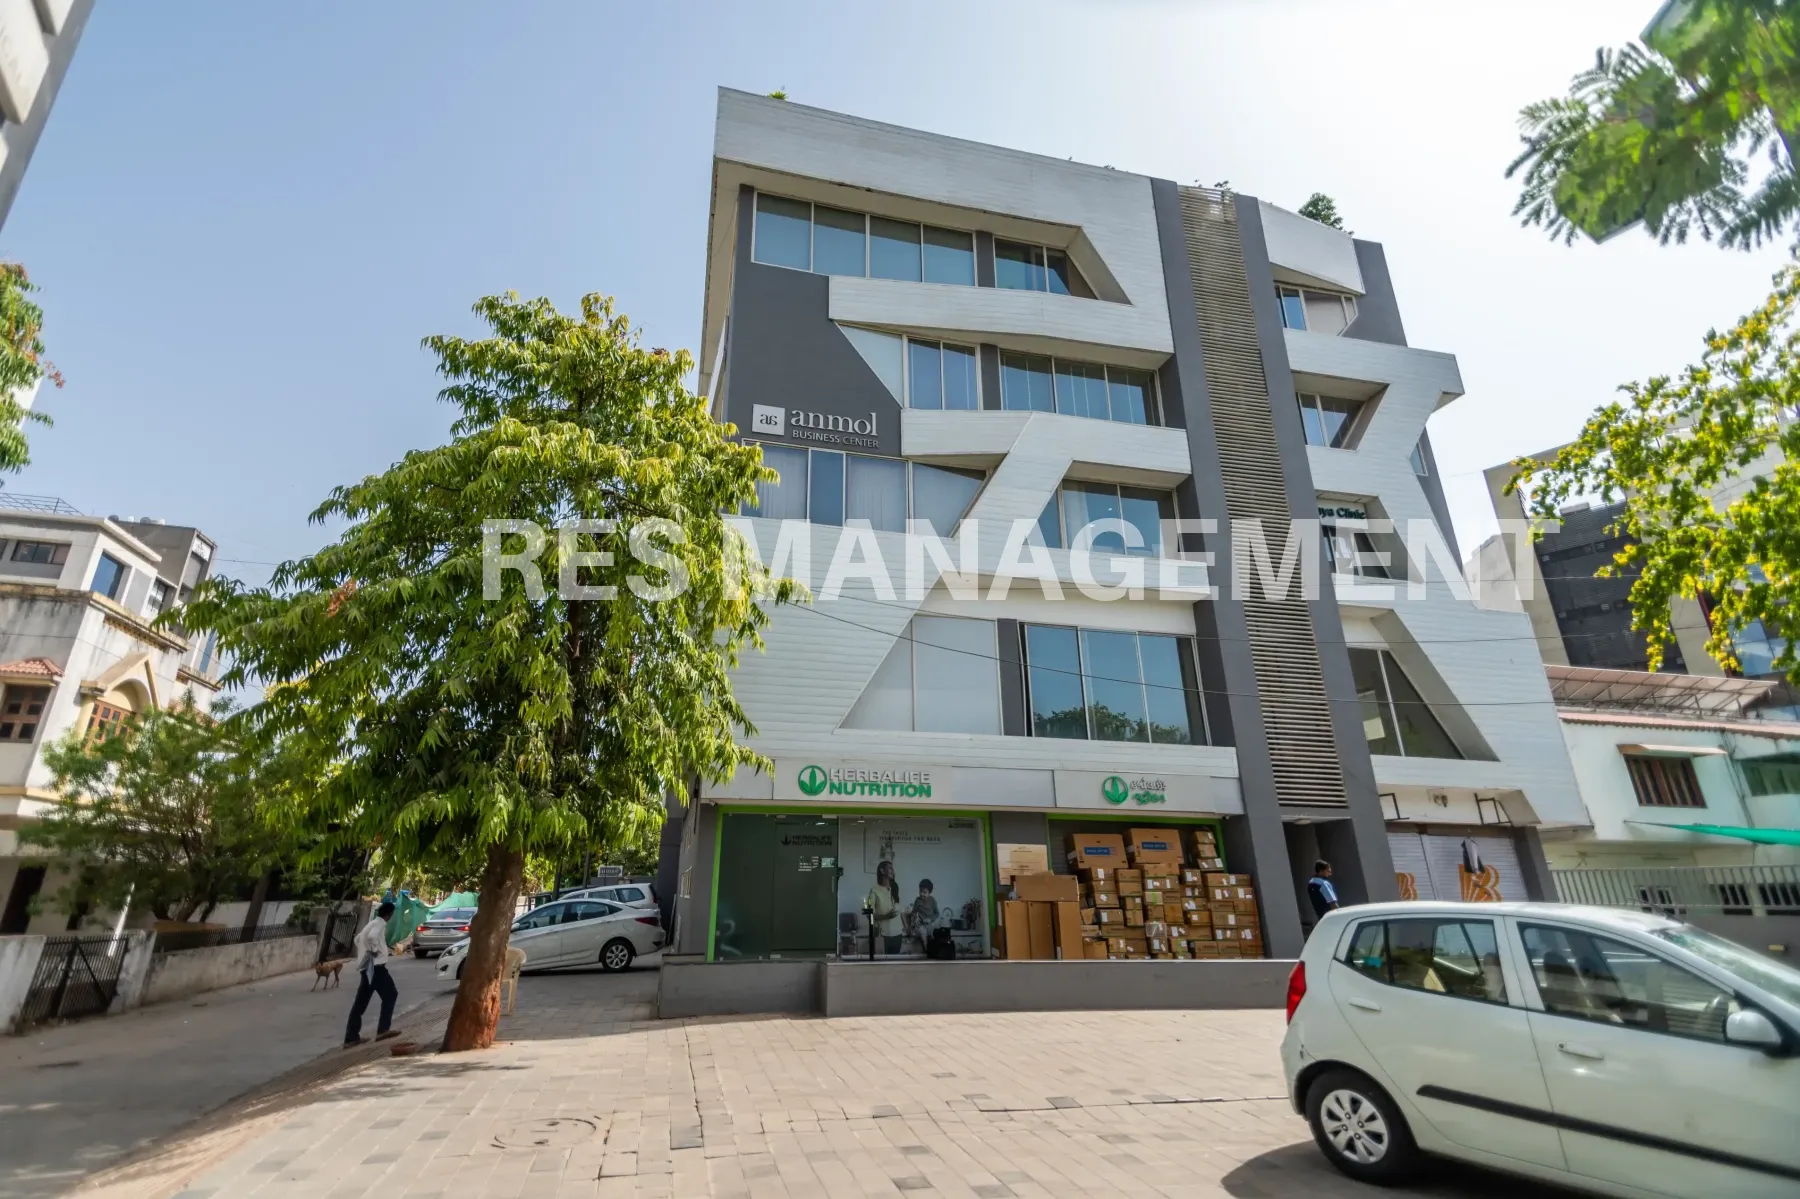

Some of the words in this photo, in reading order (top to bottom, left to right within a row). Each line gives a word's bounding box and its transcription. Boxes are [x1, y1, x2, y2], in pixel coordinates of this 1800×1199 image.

[790, 409, 878, 436] anmol
[792, 429, 840, 443] BUSINESS
[842, 436, 879, 448] CENTER
[1336, 507, 1367, 519] Clinic
[829, 767, 932, 784] HERBALIFE
[829, 782, 932, 798] NUTRITION
